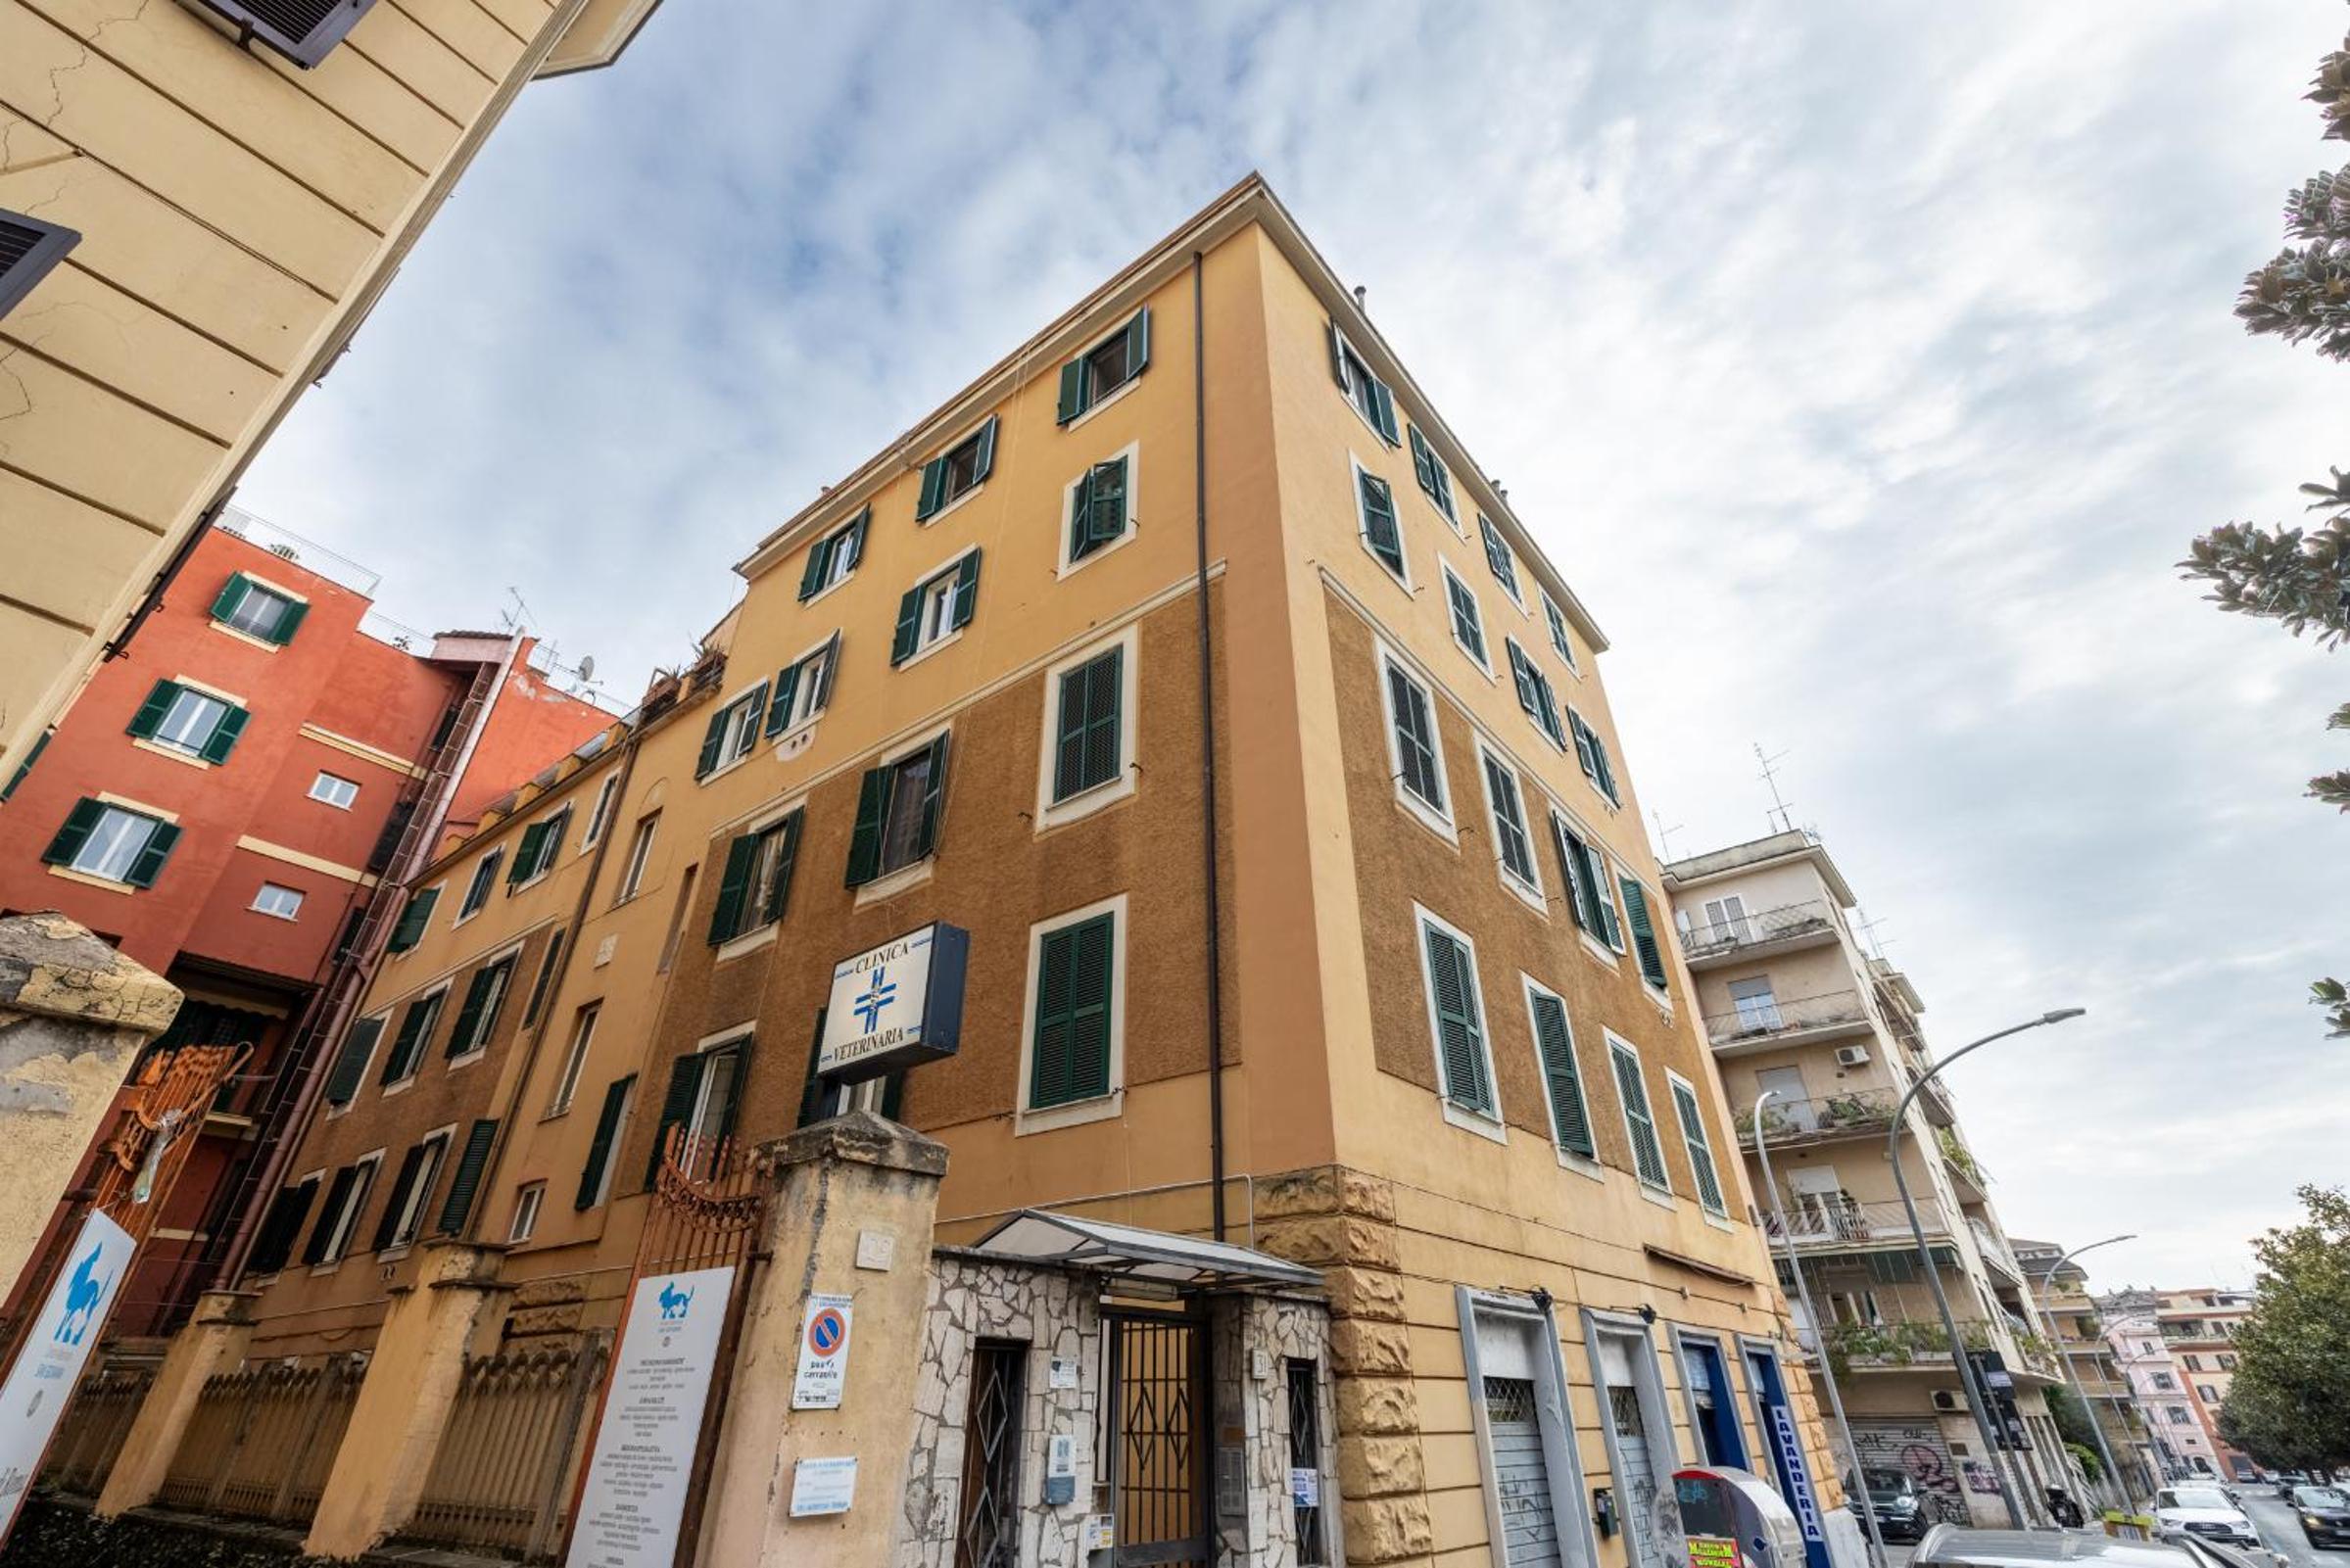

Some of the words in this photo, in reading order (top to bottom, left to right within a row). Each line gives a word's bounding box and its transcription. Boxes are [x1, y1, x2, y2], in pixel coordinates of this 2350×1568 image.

[855, 942, 909, 974] CLINICA
[833, 1027, 904, 1063] VETERINARIA
[1776, 1409, 1819, 1537] LAVANDERIA
